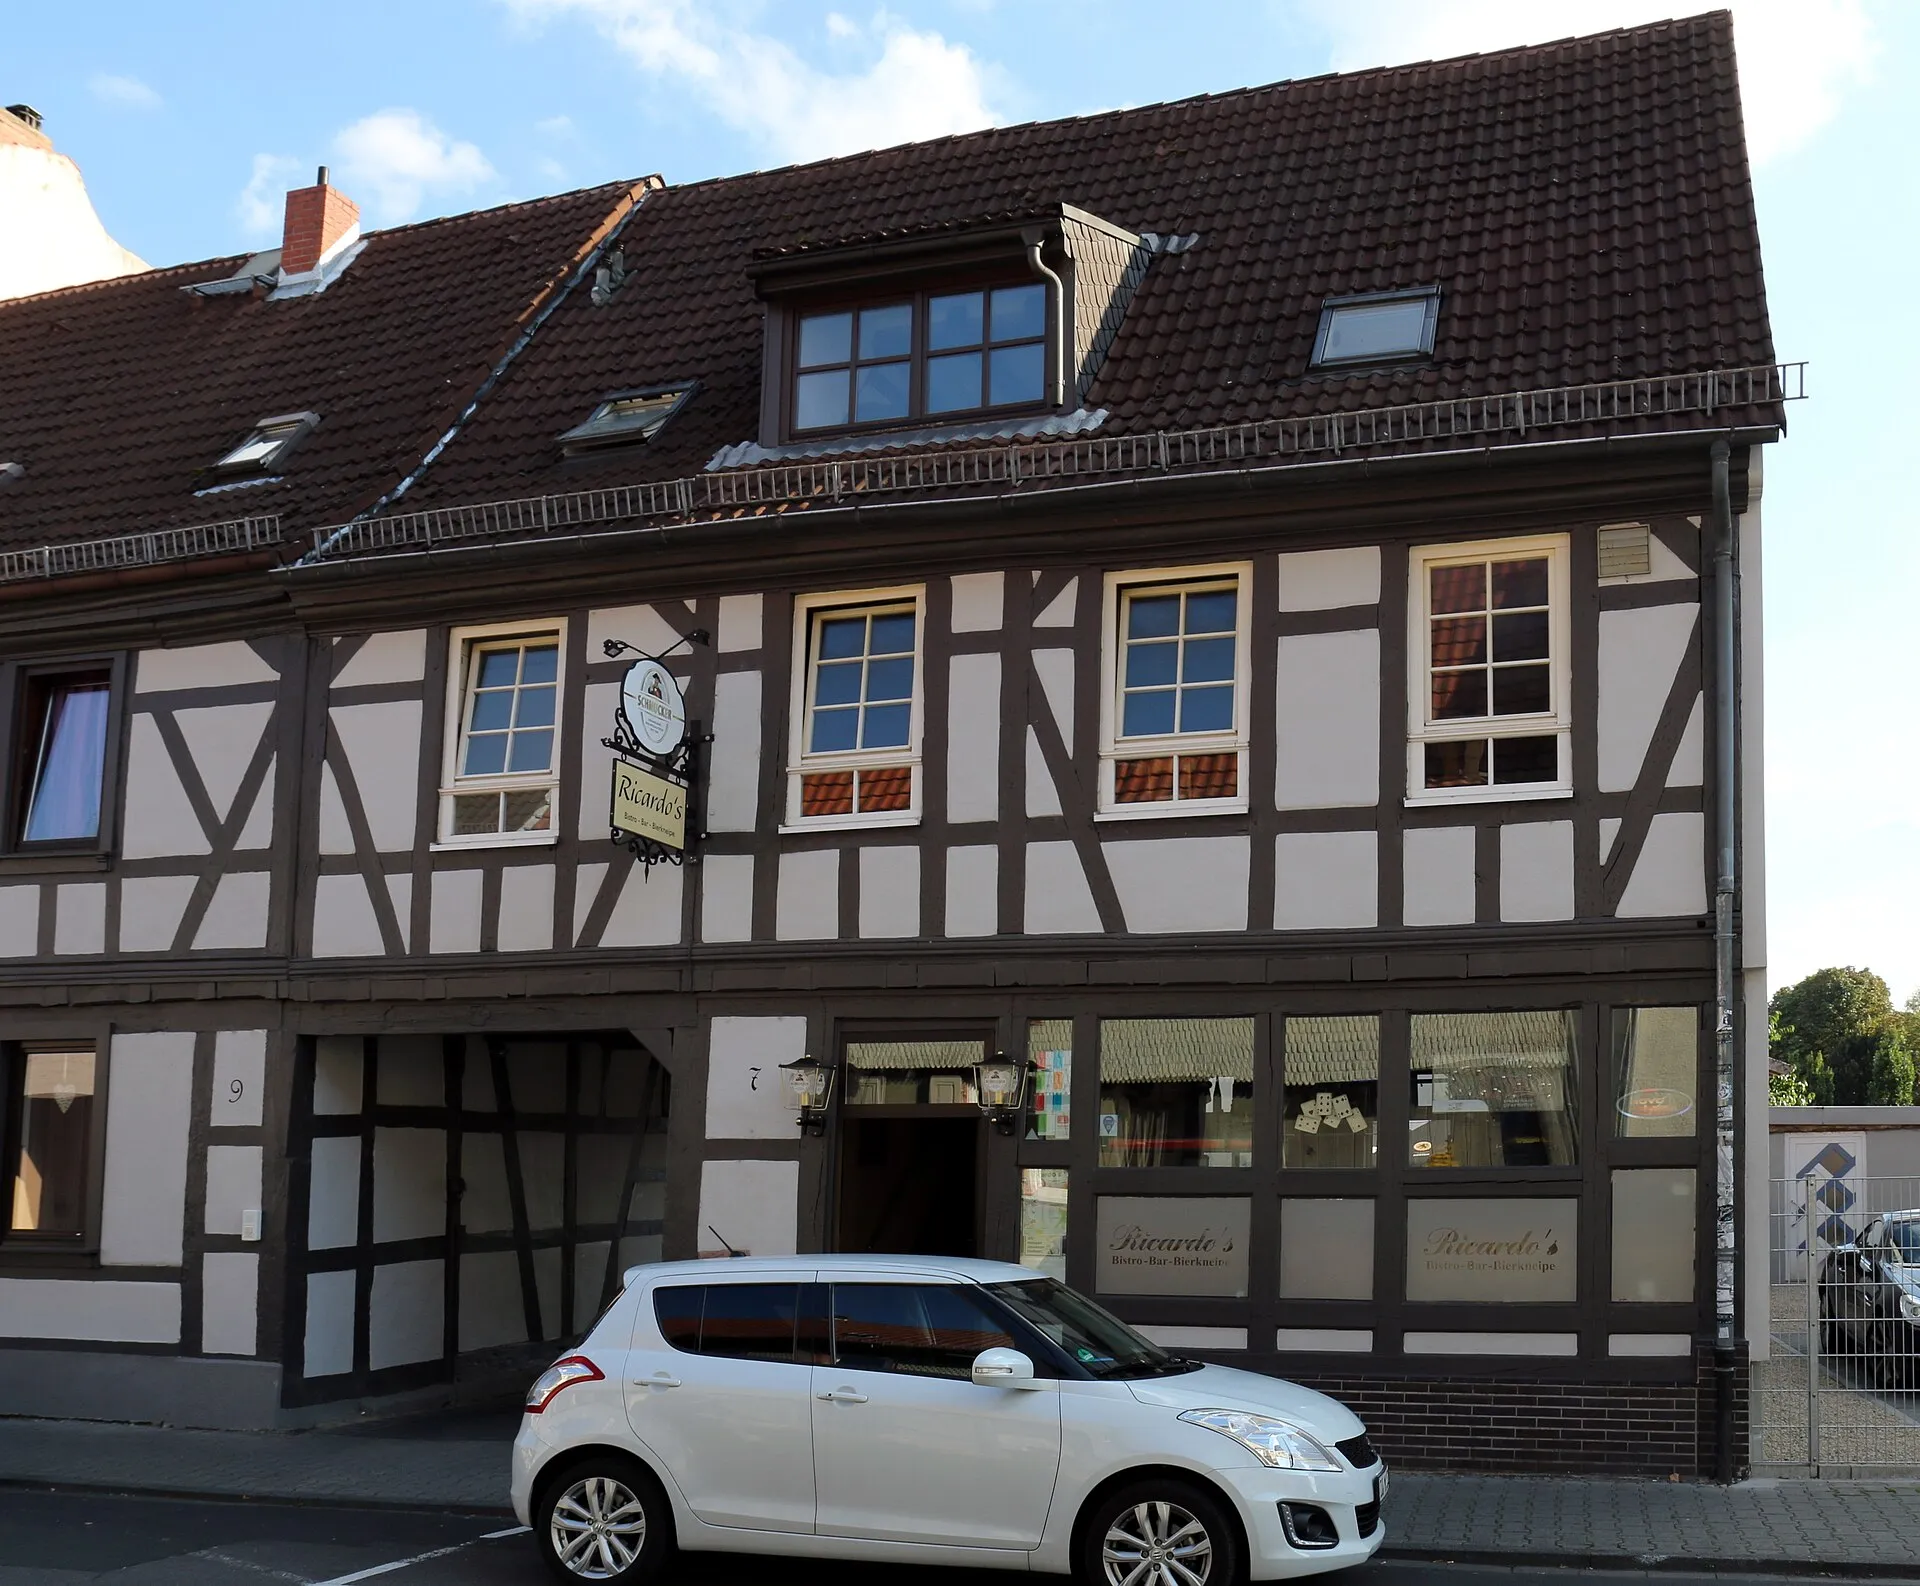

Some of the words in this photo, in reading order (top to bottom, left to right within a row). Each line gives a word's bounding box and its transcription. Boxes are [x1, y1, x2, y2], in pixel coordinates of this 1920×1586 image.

[619, 775, 682, 819] Ricardo's
[624, 812, 637, 823] Bistro
[640, 817, 649, 827] Bar
[228, 1079, 243, 1103] 9
[750, 1067, 762, 1091] 7
[1109, 1224, 1234, 1252] Ricardo's
[1423, 1226, 1560, 1256] Ricardo's
